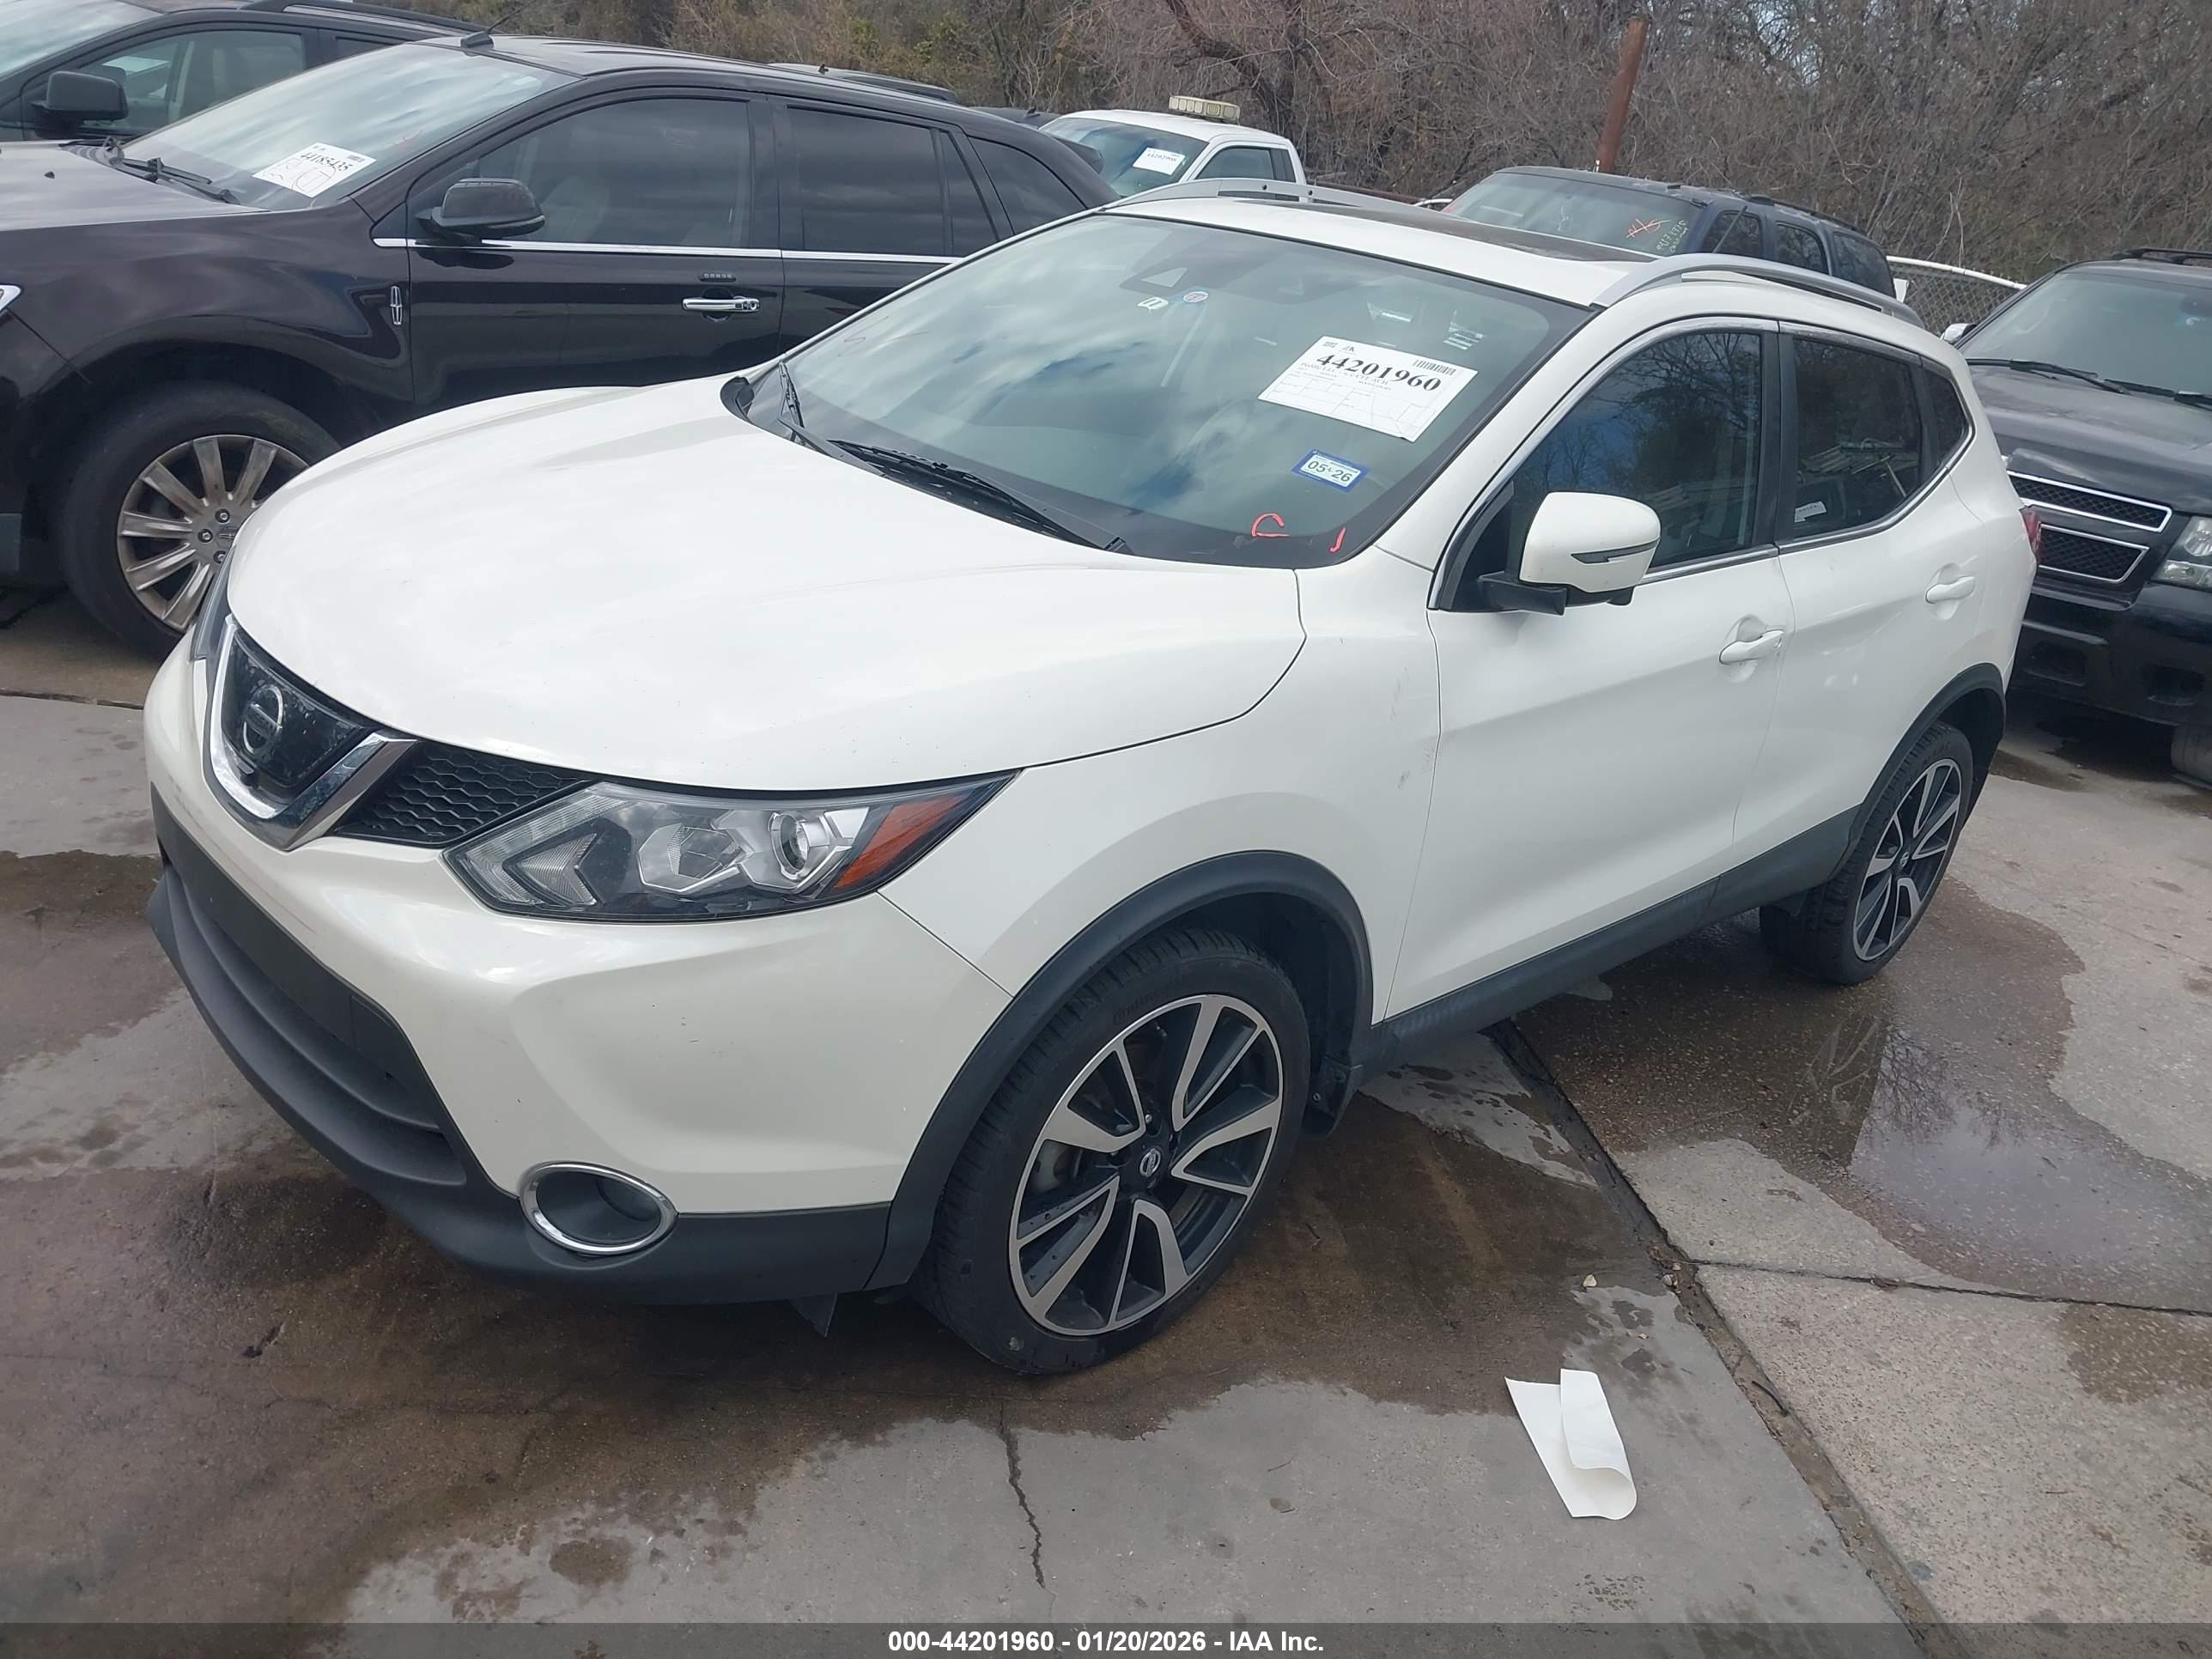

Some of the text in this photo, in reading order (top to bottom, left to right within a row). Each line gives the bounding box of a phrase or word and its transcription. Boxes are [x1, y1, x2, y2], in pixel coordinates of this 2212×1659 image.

[1316, 354, 1441, 392] 44201960
[1307, 460, 1353, 483] 05 26
